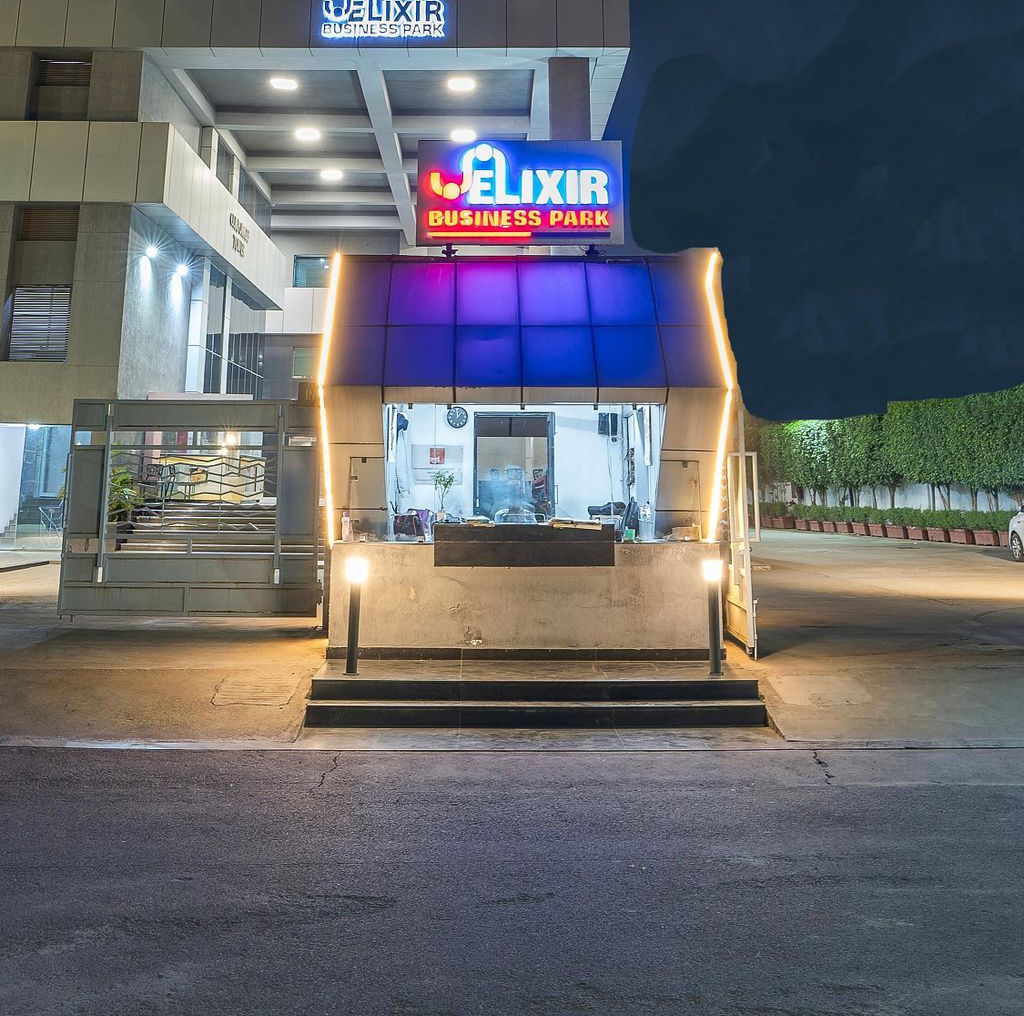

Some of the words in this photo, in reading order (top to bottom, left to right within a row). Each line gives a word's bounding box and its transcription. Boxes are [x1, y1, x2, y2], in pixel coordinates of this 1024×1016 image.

[322, 23, 398, 36] BUSINESS
[402, 23, 444, 36] PARK
[428, 209, 542, 228] BUSINESS
[549, 209, 610, 227] PARK
